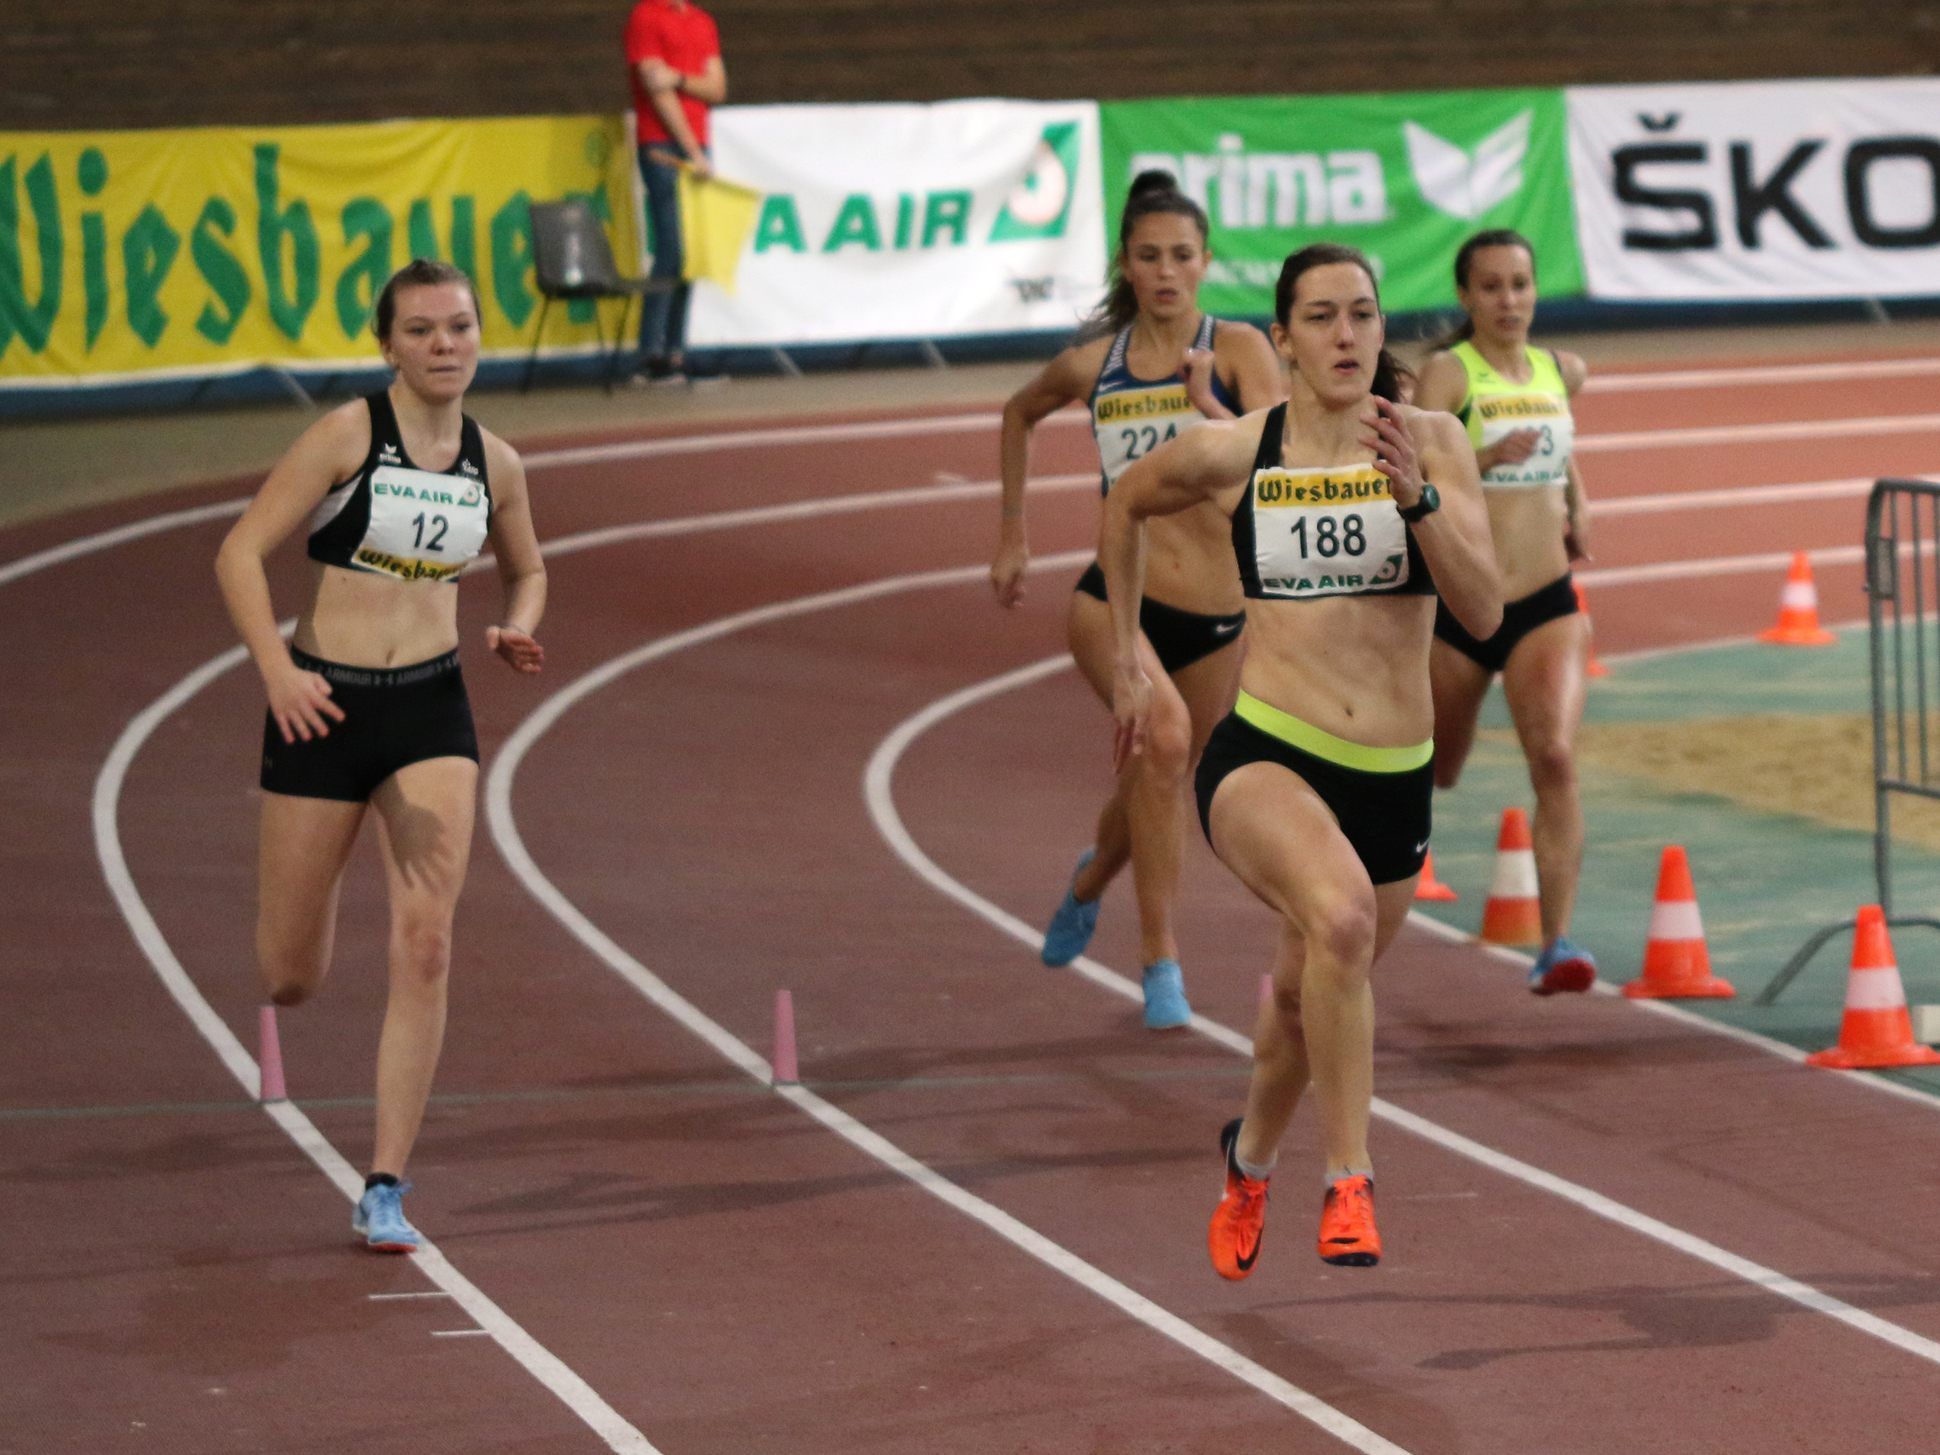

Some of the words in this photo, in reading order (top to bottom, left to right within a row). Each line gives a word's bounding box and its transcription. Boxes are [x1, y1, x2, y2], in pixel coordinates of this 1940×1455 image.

[822, 189, 973, 253] AIR
[0, 144, 611, 360] Wiesbaue
[374, 483, 417, 500] EVA
[419, 488, 454, 505] AIR
[412, 511, 449, 552] 12
[1291, 513, 1367, 559] 188
[1263, 577, 1315, 590] EVA
[1318, 574, 1364, 589] AIR
